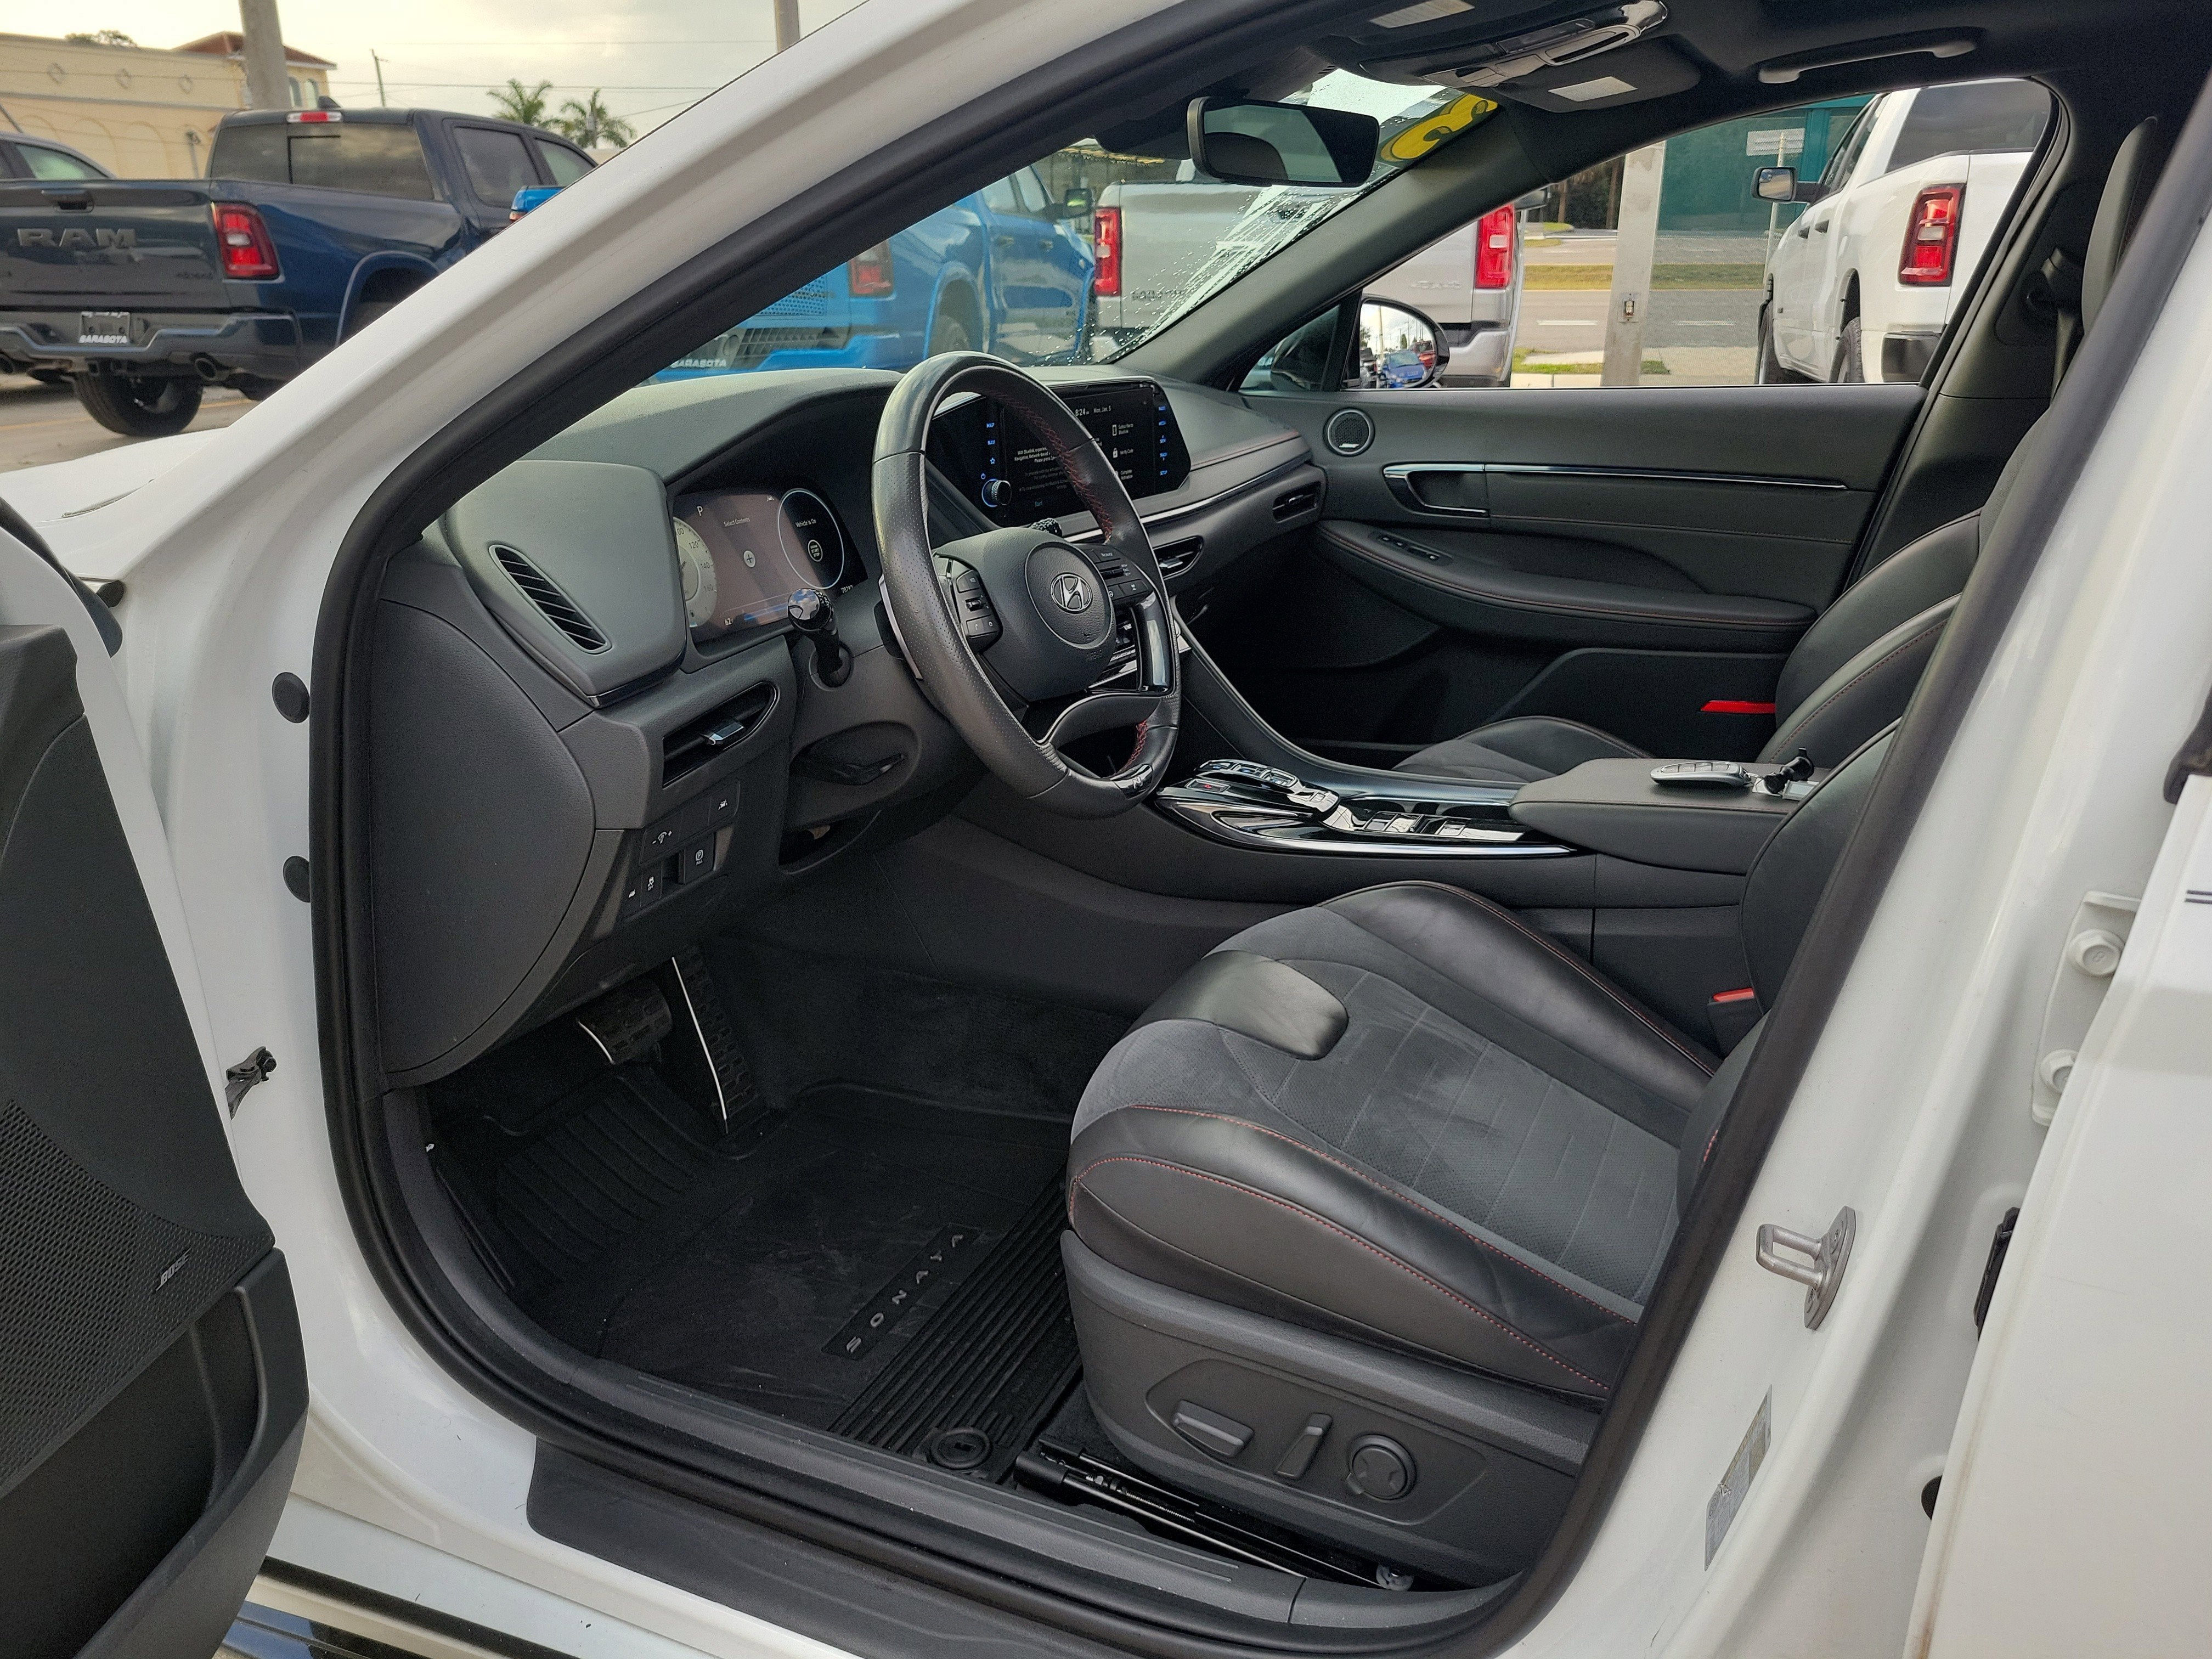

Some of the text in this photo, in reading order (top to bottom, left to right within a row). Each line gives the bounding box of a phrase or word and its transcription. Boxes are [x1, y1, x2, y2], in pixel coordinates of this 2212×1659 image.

[18, 228, 137, 247] RAM
[78, 335, 128, 344] SARASOTA
[697, 505, 703, 516] P
[676, 527, 685, 535] 00
[689, 540, 699, 549] 120
[704, 584, 714, 592] 160
[155, 1247, 192, 1291] BOSE
